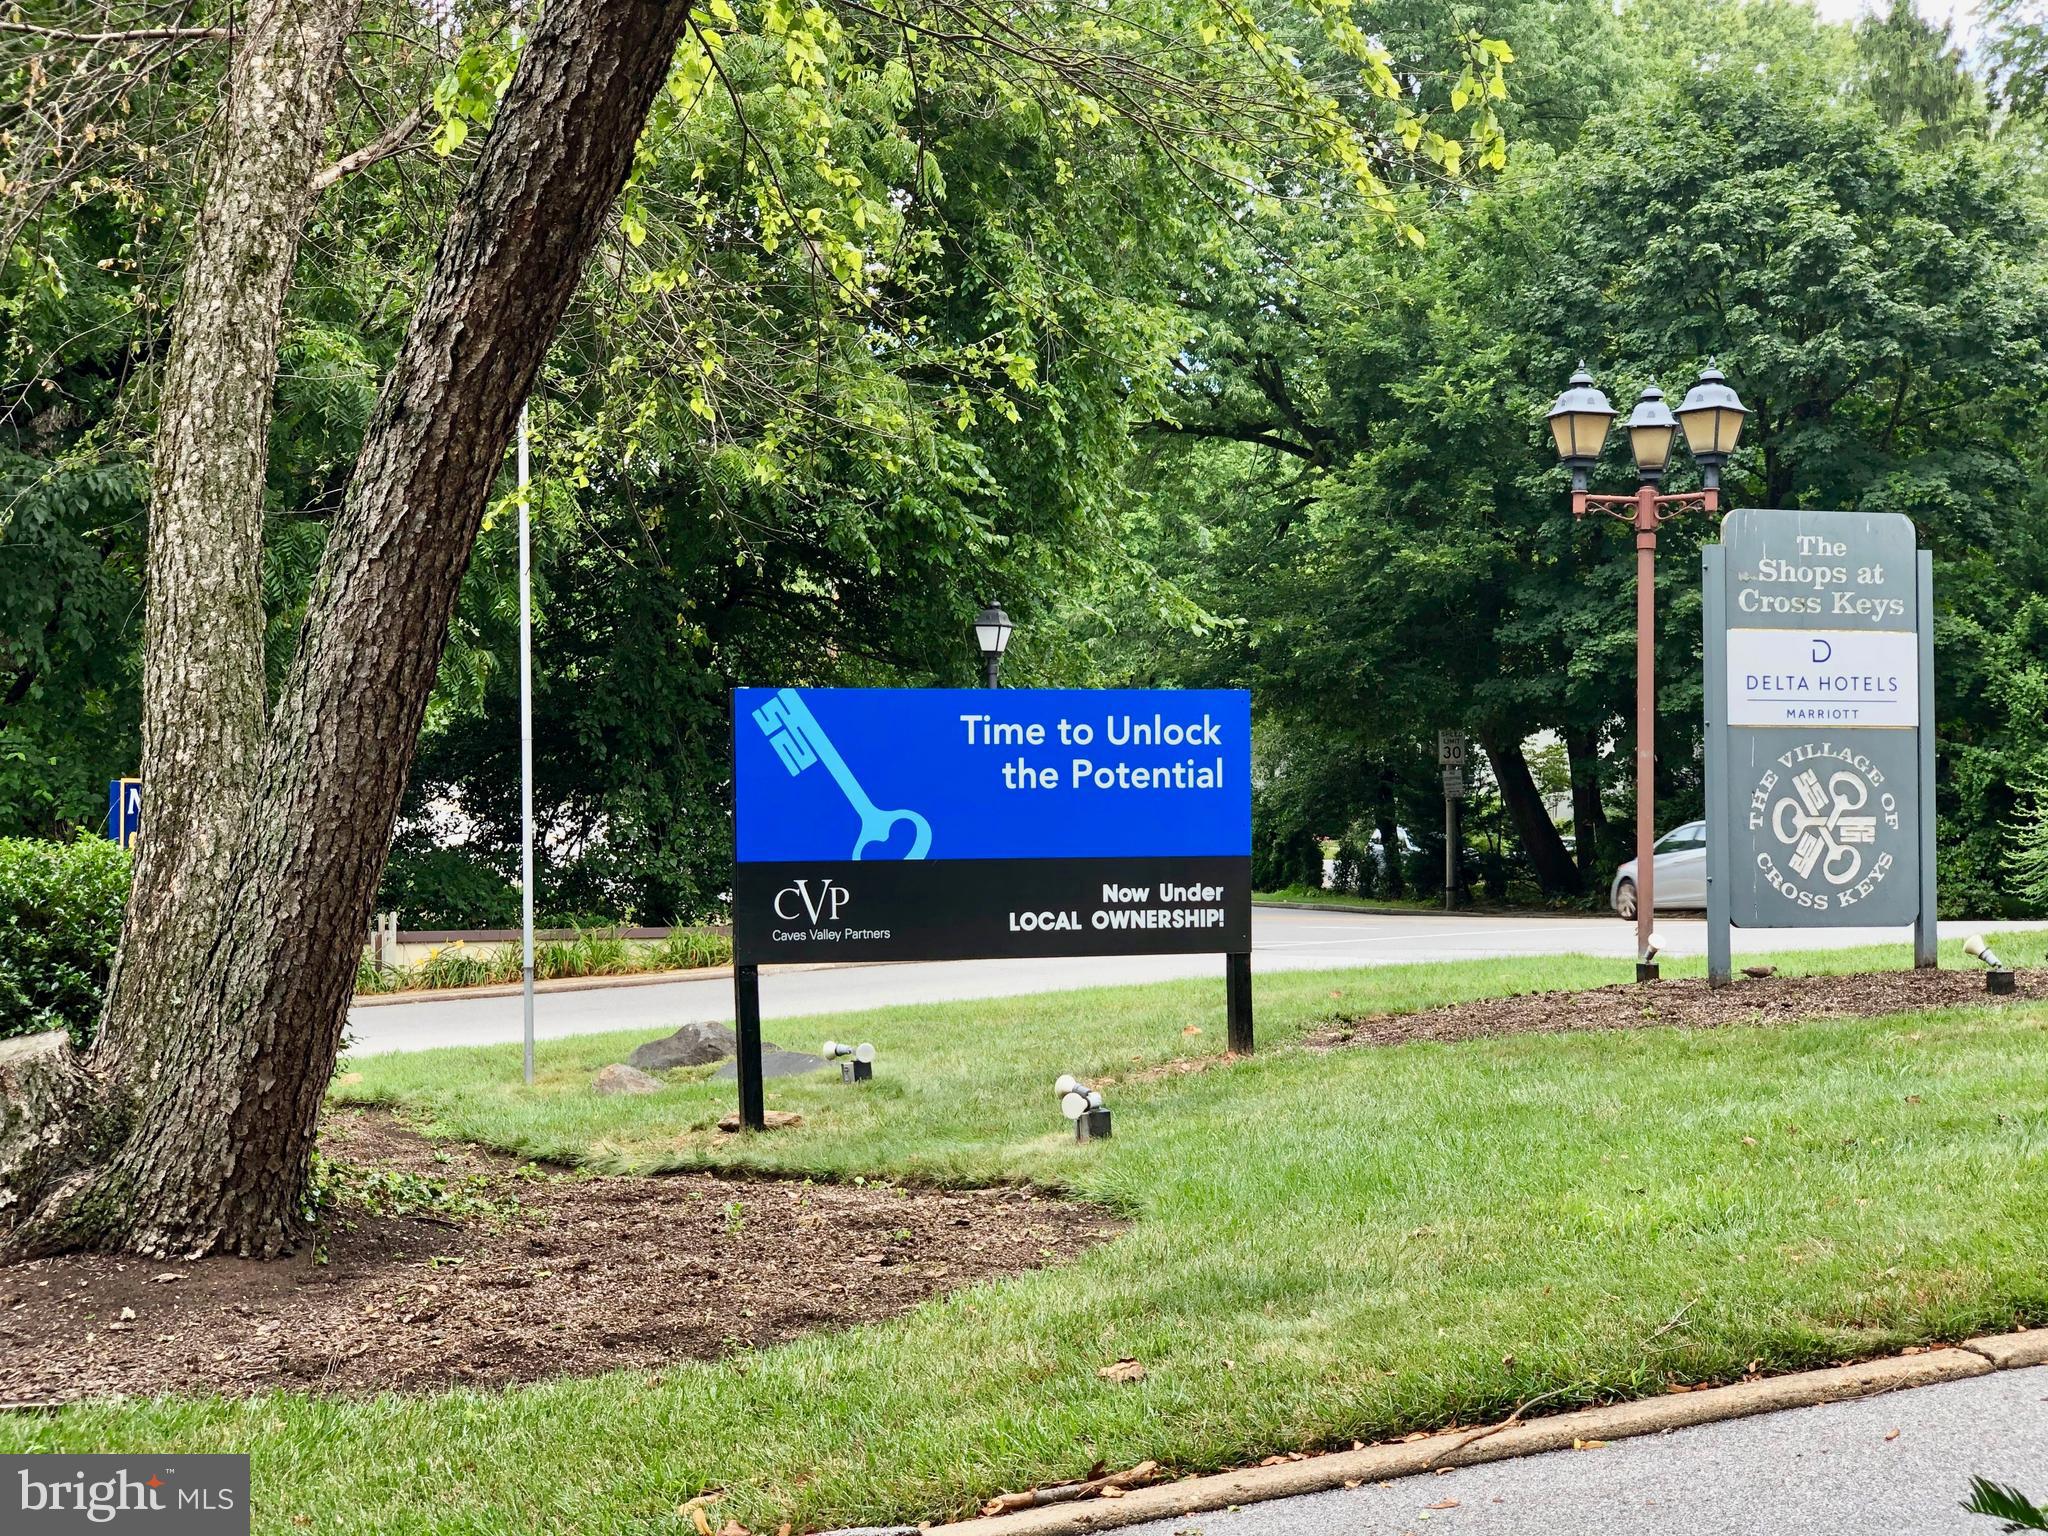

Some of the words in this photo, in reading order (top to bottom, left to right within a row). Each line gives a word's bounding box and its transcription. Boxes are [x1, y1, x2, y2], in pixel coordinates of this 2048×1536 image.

[1797, 536, 1847, 557] The
[1758, 559, 1848, 590] Shops
[1857, 563, 1884, 585] at
[1738, 589, 1821, 613] Cross
[1831, 592, 1905, 622] Keys
[1746, 675, 1809, 691] DELTA
[1819, 676, 1898, 692] HOTELS
[1786, 709, 1859, 719] MARRIOTT
[960, 714, 1046, 745] Time
[1057, 717, 1093, 745] to
[1107, 713, 1222, 746] Unlock
[1443, 746, 1461, 759] 30
[1002, 758, 1059, 789] the
[1072, 757, 1223, 789] Potential
[1749, 769, 1780, 831] THE
[1777, 742, 1886, 788] VILLAGE
[1881, 792, 1900, 830] OF
[1102, 883, 1150, 903] Now
[1159, 882, 1224, 903] Under
[1756, 852, 1829, 910] CROSS
[1836, 851, 1894, 908] KEYS
[774, 879, 850, 926] CVP
[1009, 911, 1083, 932] LOCAL
[1091, 908, 1225, 930] OWNERSHIP!
[772, 929, 807, 942] Caves
[809, 928, 842, 942] Valley
[844, 927, 891, 940] Partners
